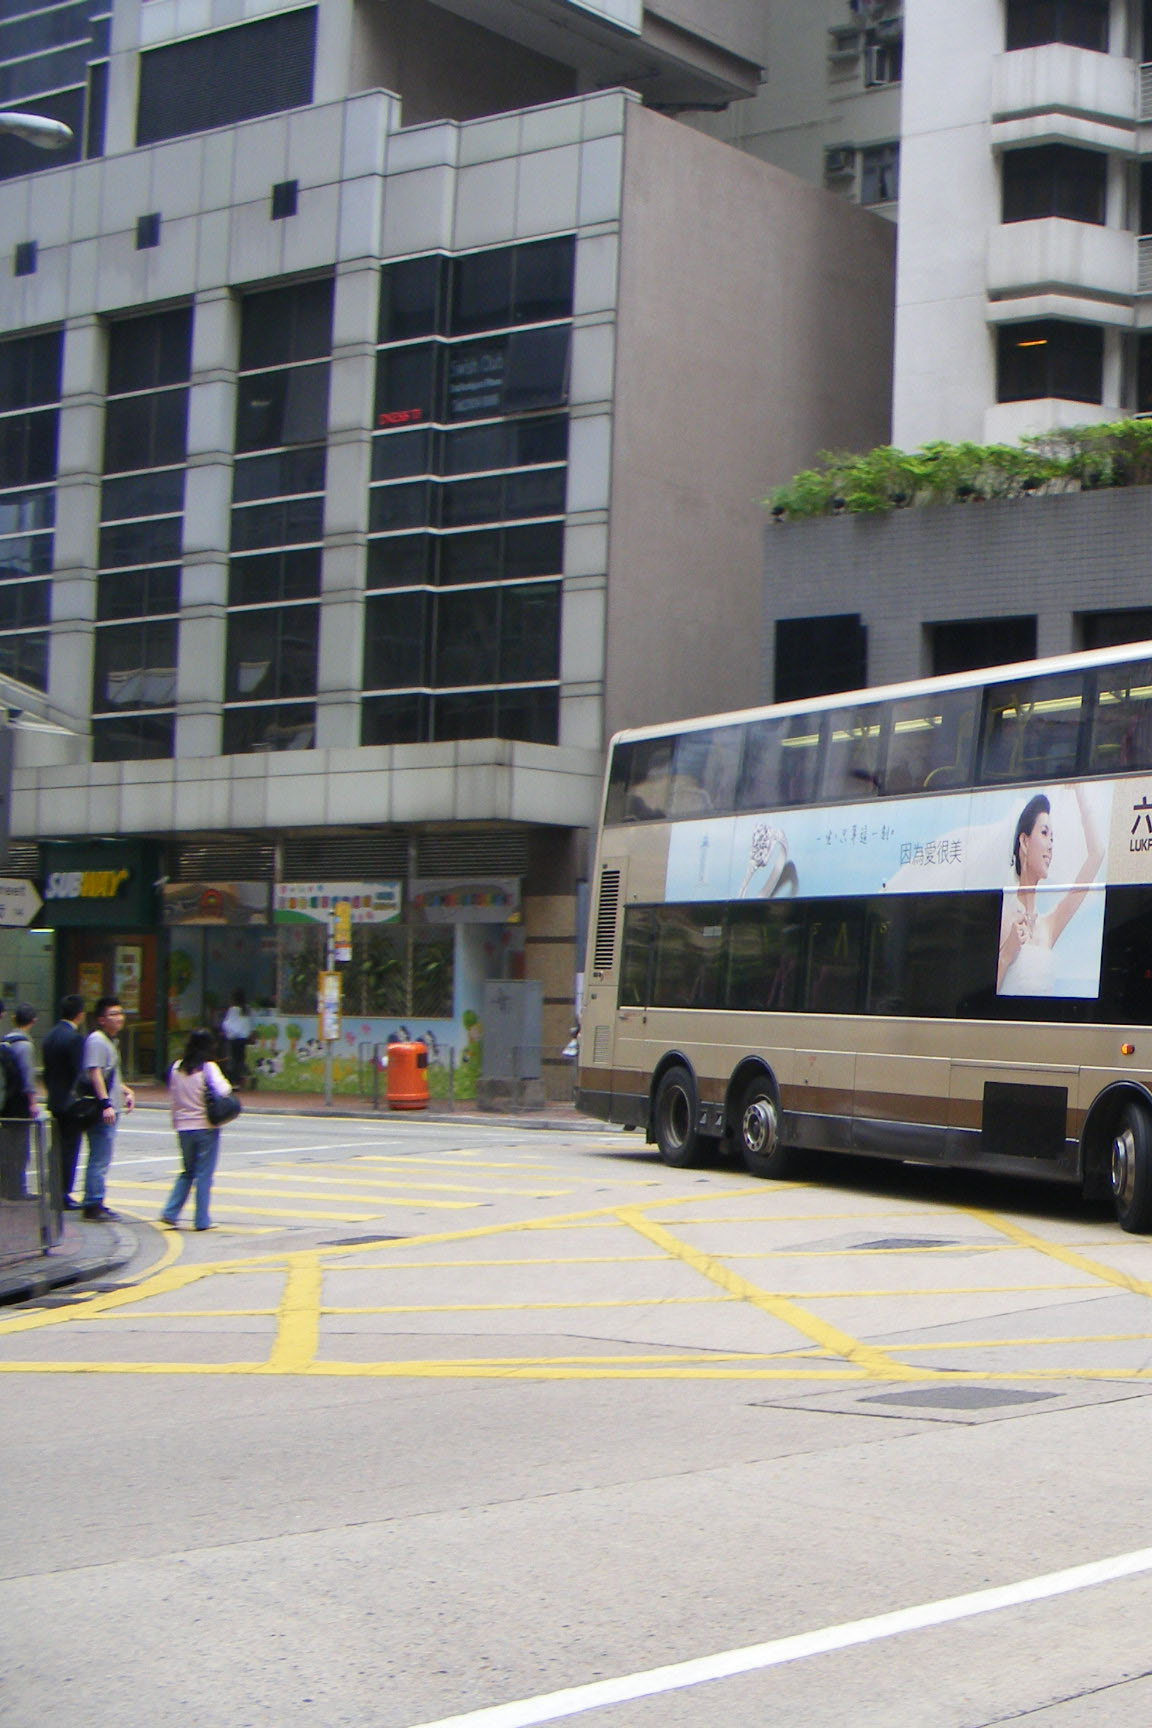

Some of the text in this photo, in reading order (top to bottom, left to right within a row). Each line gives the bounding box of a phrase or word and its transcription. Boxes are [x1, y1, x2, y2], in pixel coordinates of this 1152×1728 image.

[900, 840, 962, 866] 因為愛很美
[46, 870, 128, 898] SUBWAY
